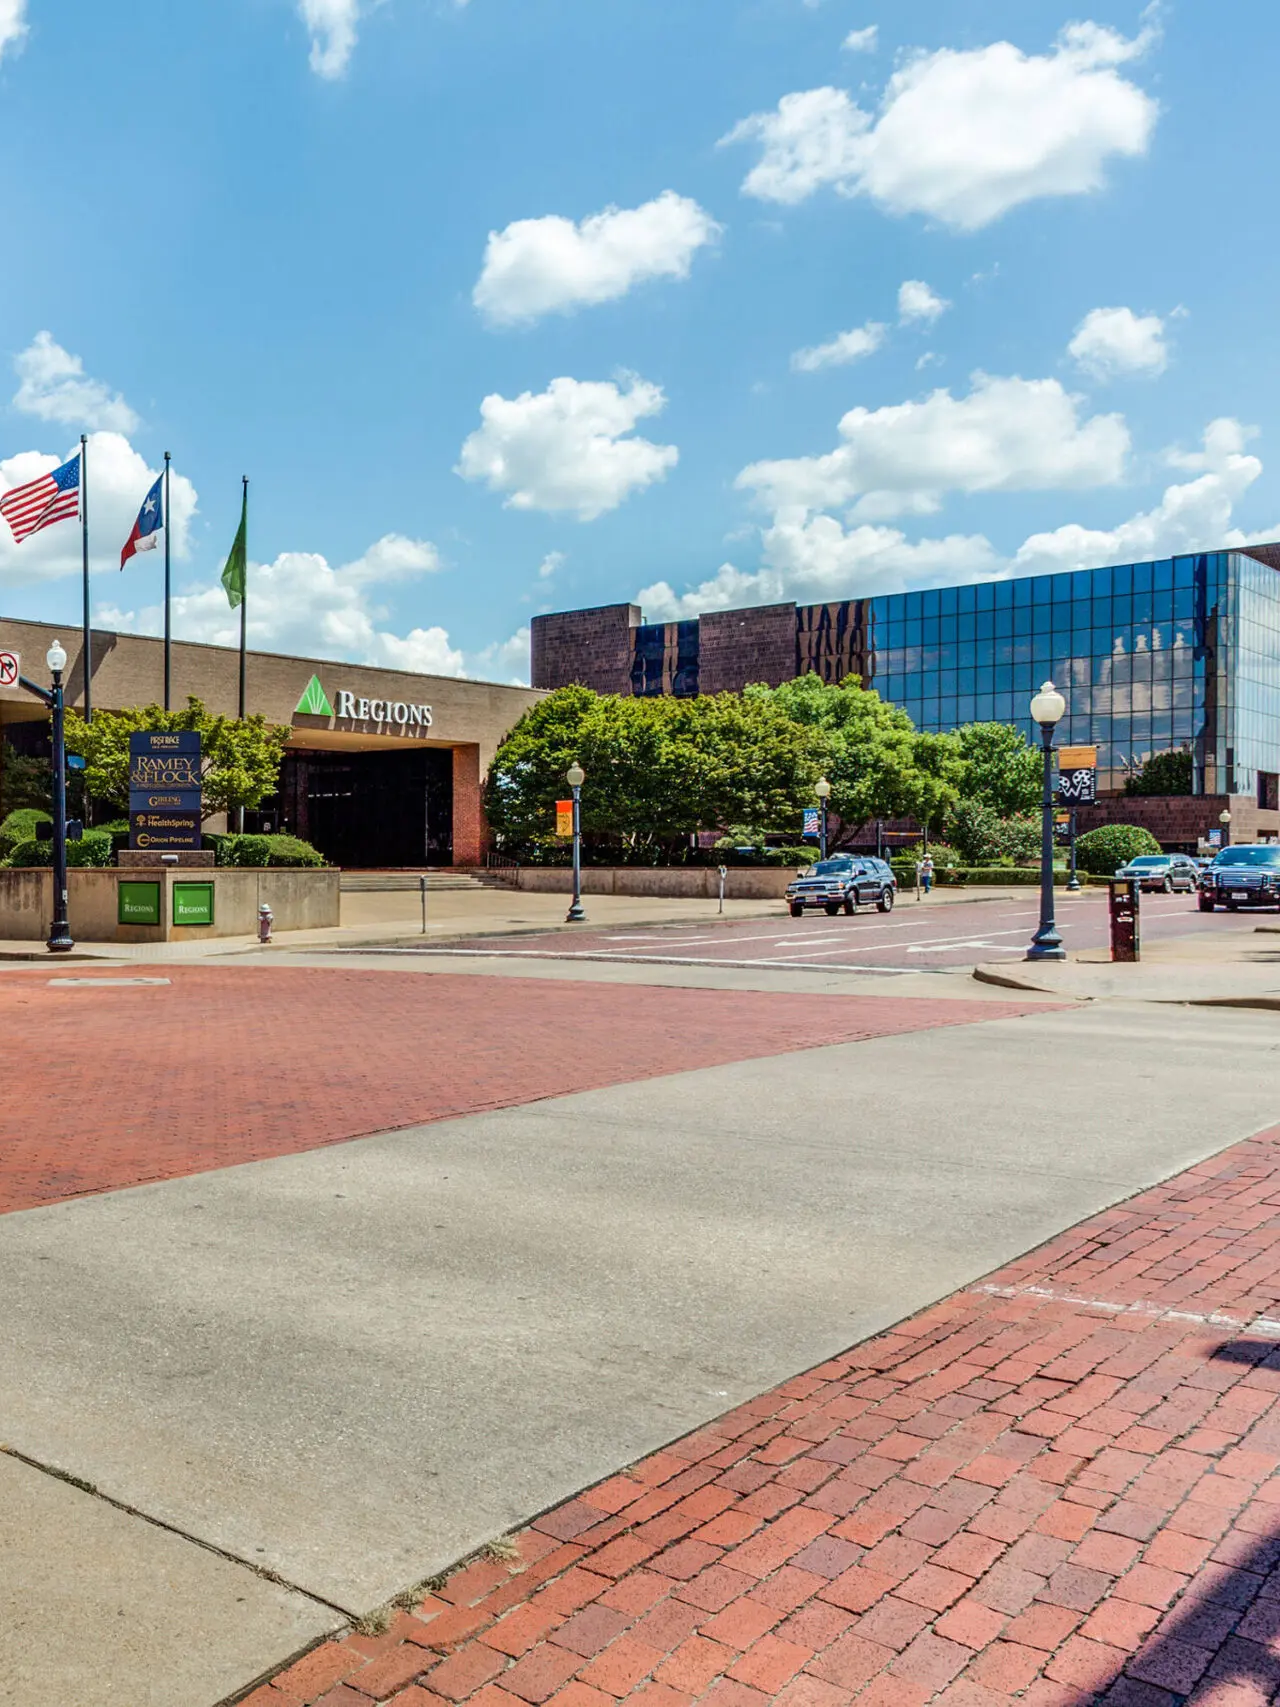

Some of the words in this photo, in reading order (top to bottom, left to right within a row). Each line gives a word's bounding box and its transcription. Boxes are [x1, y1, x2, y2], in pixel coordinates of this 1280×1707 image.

[338, 690, 433, 726] REGIONS
[136, 756, 195, 772] RAMEY
[124, 904, 154, 913] REGIONS
[178, 905, 208, 914] REGIONS
